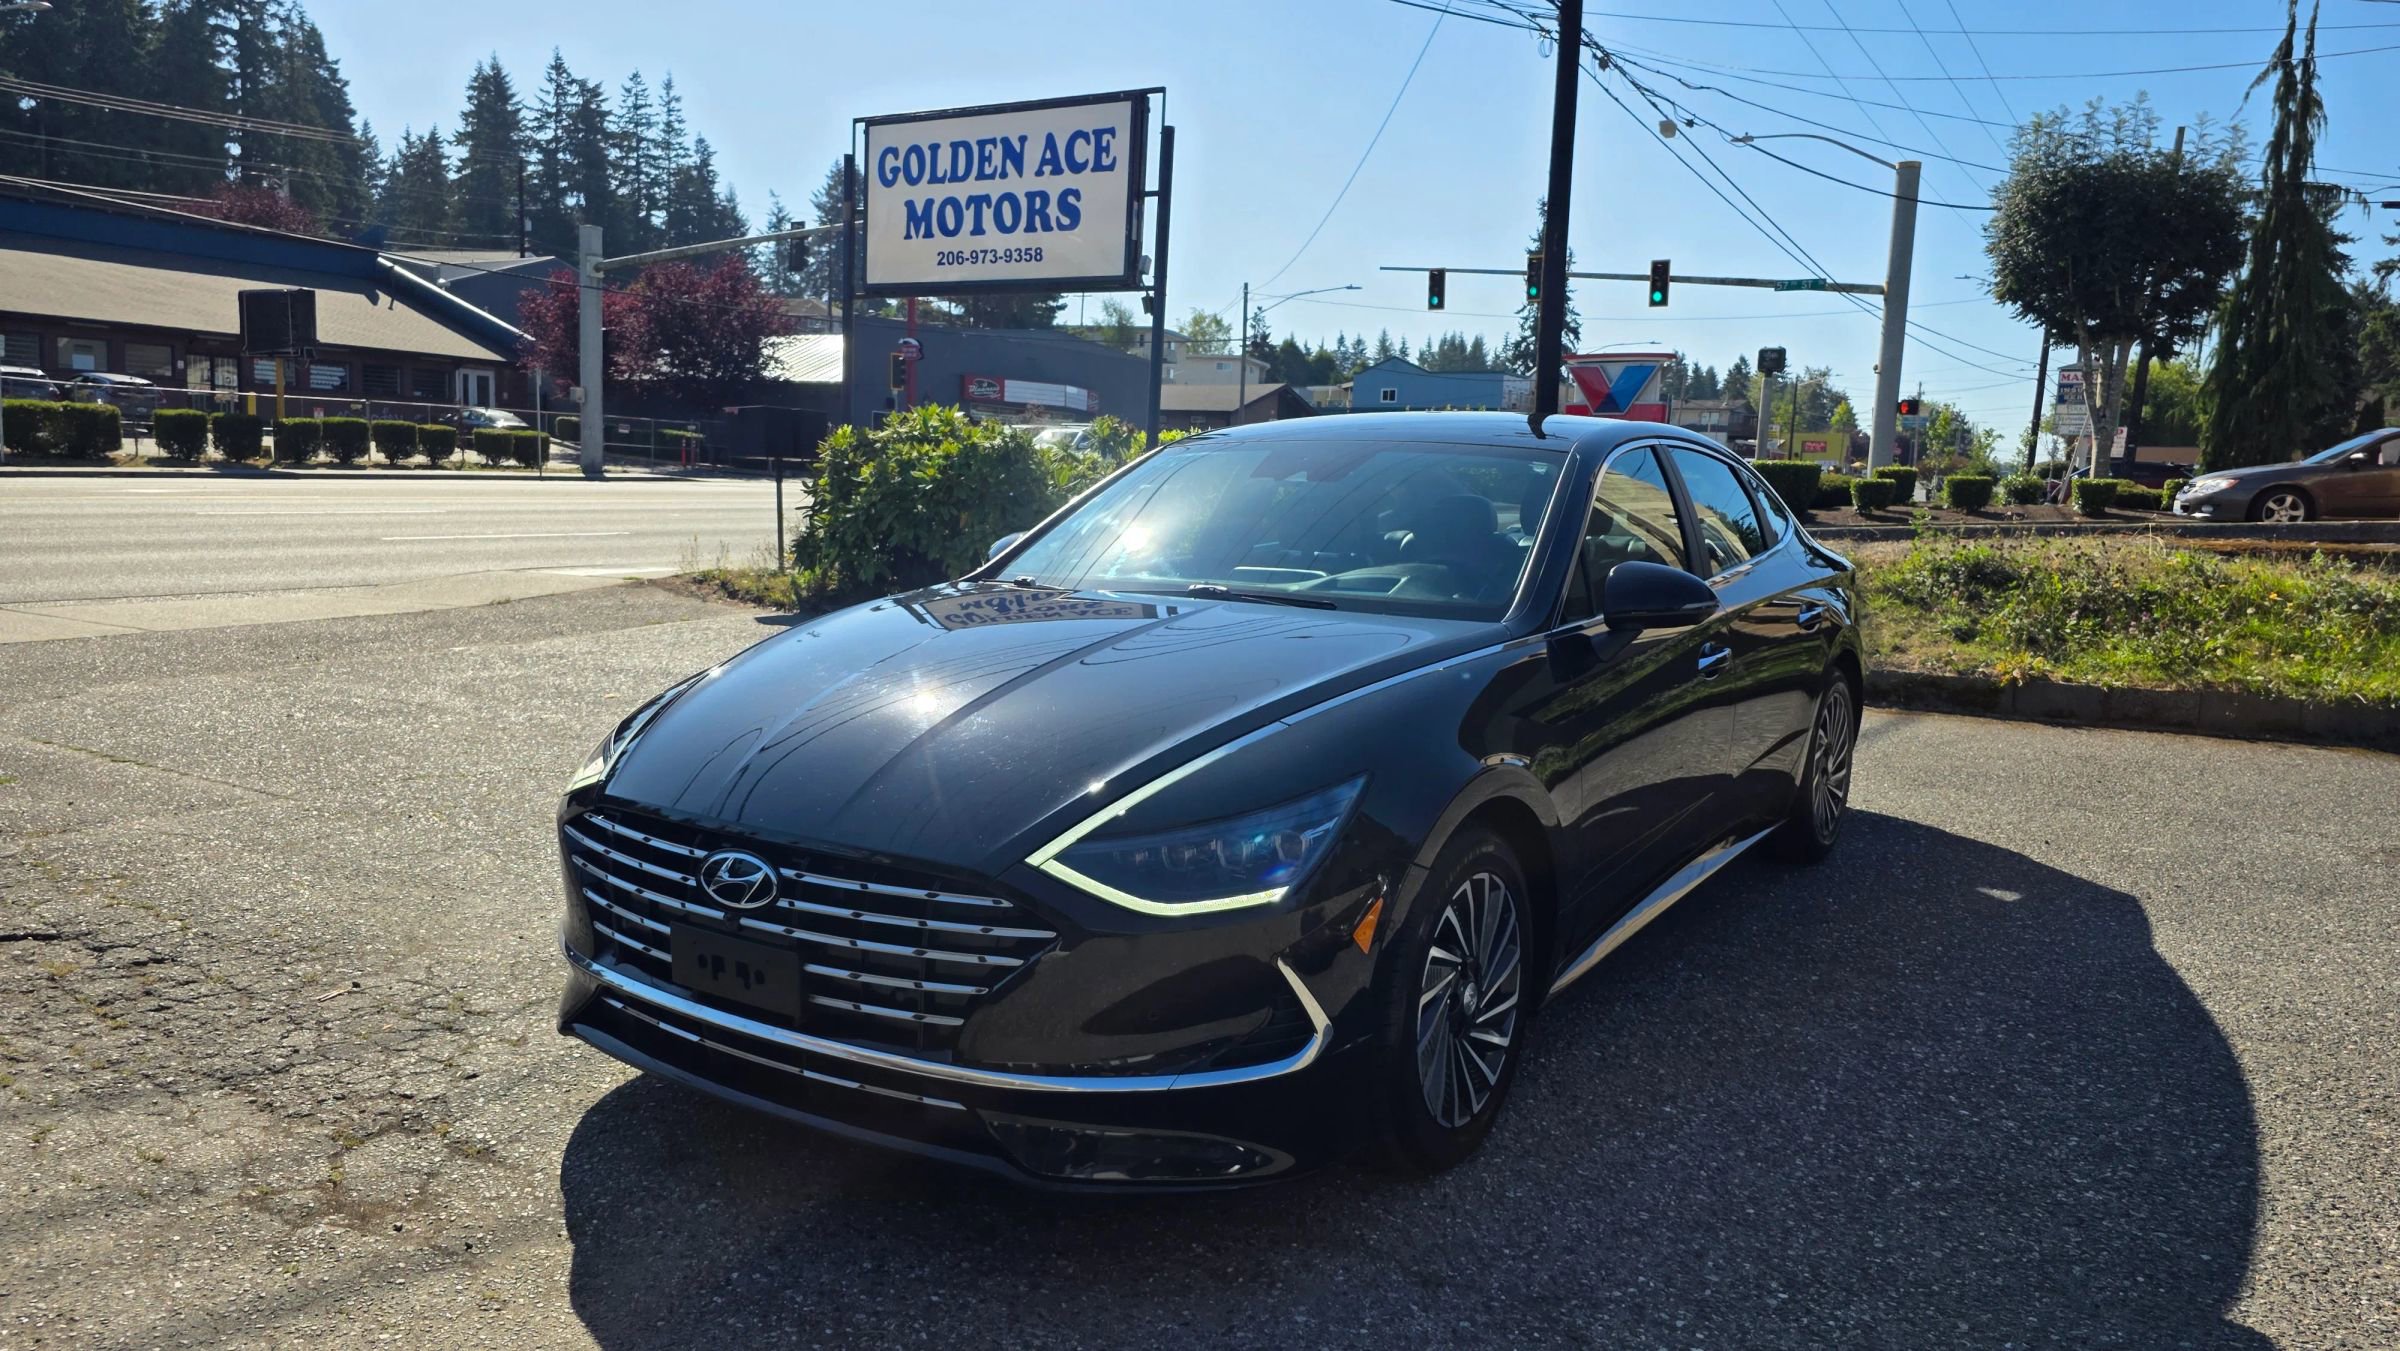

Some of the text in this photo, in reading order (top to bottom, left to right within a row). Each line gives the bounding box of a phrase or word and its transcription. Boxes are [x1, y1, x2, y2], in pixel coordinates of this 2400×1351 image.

[877, 126, 1117, 188] GOLDEN ACE
[903, 187, 1082, 240] MOTORS
[936, 247, 1044, 266] 206-973-9358
